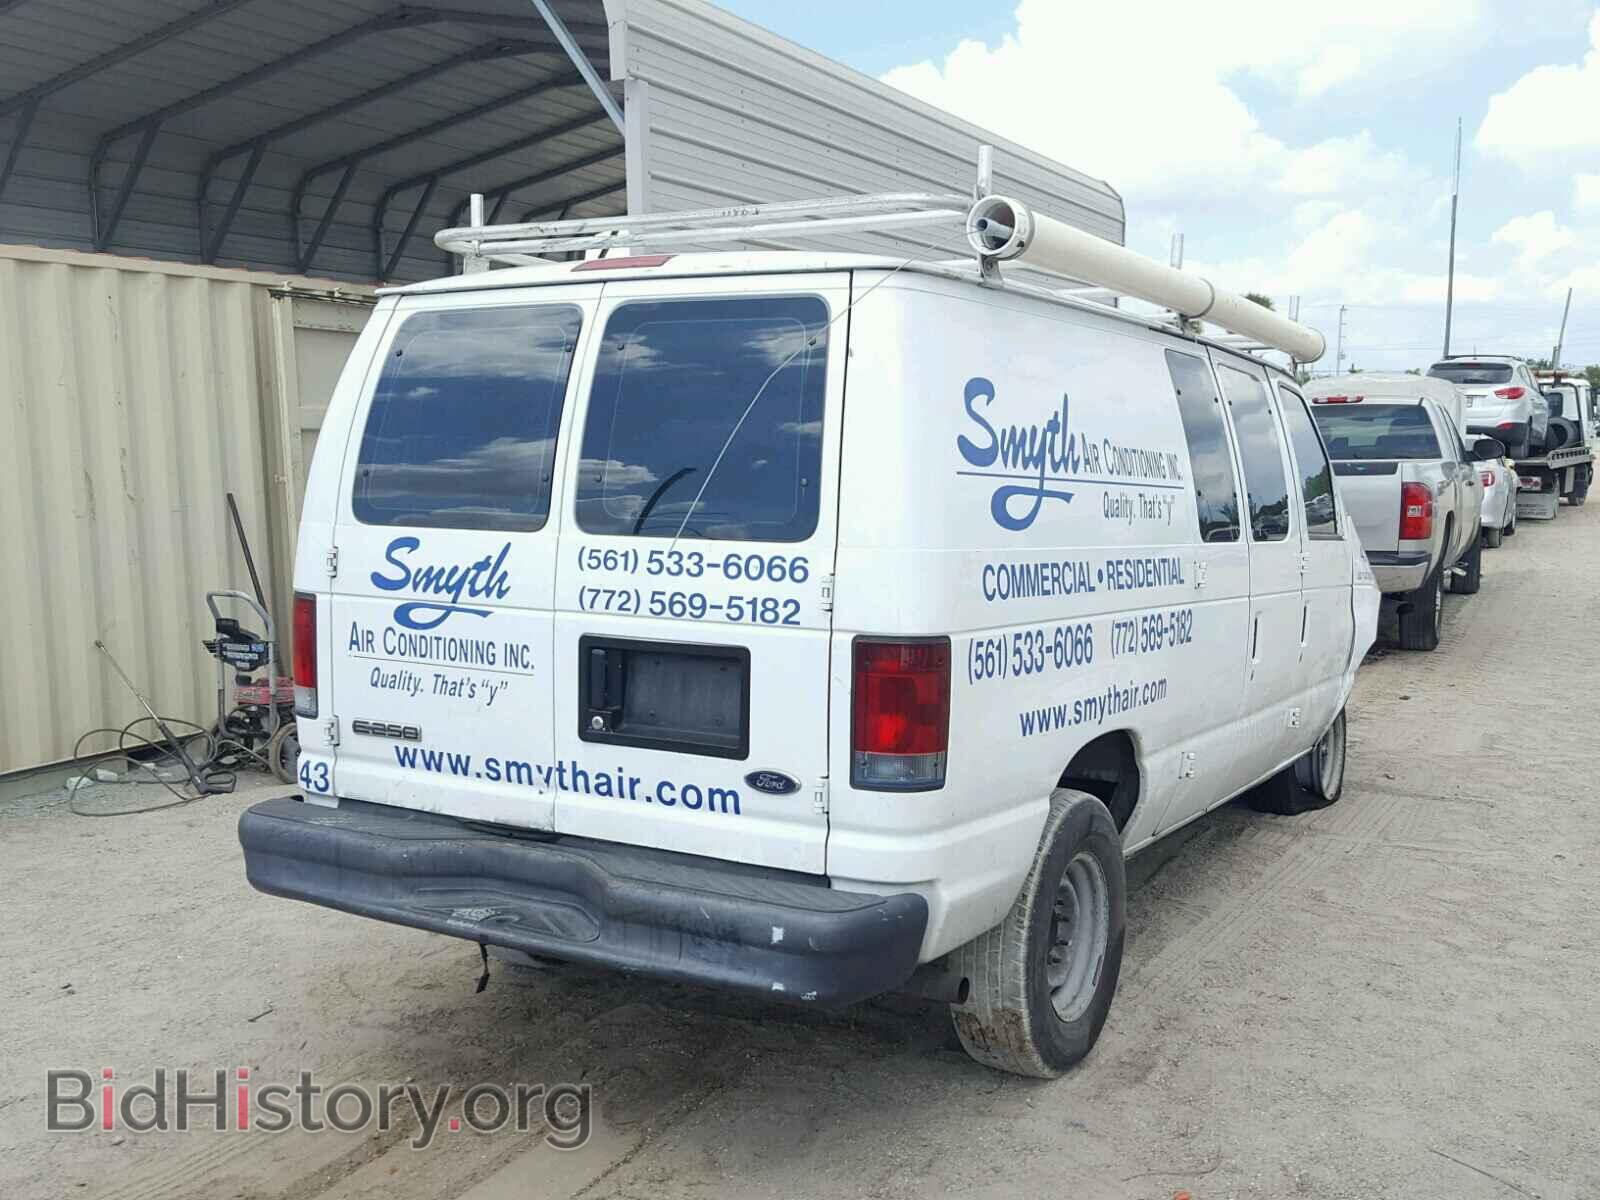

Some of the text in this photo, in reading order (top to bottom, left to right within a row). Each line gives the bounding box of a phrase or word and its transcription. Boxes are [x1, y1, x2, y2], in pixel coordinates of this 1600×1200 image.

[957, 377, 1080, 531] Smyth
[1166, 452, 1184, 480] INC.
[1103, 491, 1136, 526] Quality.
[370, 536, 512, 629] Smyth
[578, 546, 810, 584] (561) 533-6066
[983, 557, 1185, 601] COMMERCIAL RESIDENTIAL
[578, 585, 802, 625] (772) 569-5182
[504, 643, 535, 670] INC.
[967, 608, 1194, 685] (561) 533-6066 (772) 569-5182
[370, 667, 425, 697] Quality.
[432, 673, 477, 699] That's
[1019, 677, 1168, 737] www.smythair.com
[299, 761, 330, 792] 43
[395, 746, 742, 815] www.smythair.com
[756, 773, 786, 790] Ford
